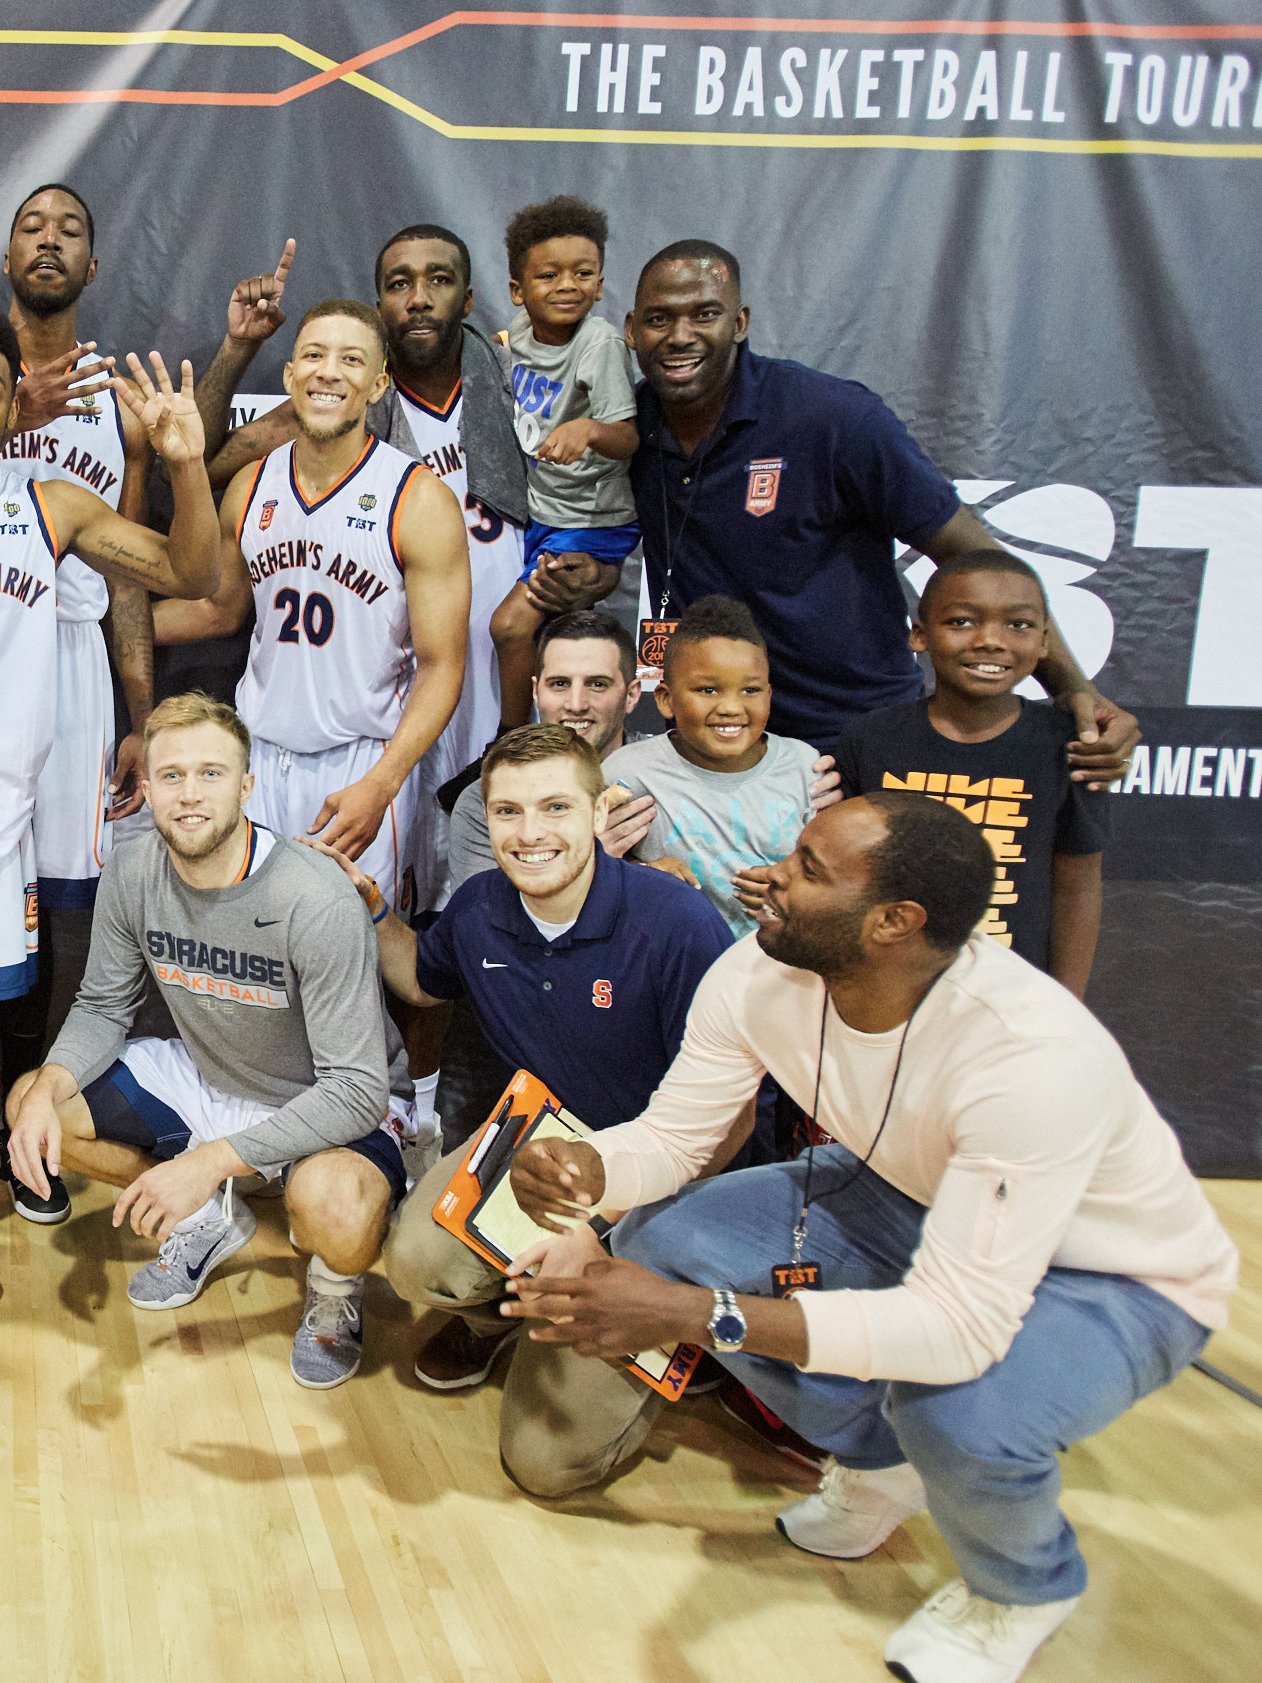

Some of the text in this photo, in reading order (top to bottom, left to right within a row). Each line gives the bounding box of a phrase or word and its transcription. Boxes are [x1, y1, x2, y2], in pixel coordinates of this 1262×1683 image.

[560, 42, 1262, 129] THE BASKETBALL TOUR
[61, 446, 118, 496] ARMY
[325, 552, 389, 606] ARMY
[274, 586, 336, 648] 20
[1109, 744, 1262, 798] AMENT
[146, 930, 287, 987] SYRACUSE
[156, 965, 279, 1007] BASKETBALL
[592, 978, 613, 1009] S
[666, 1344, 697, 1393] RMY
